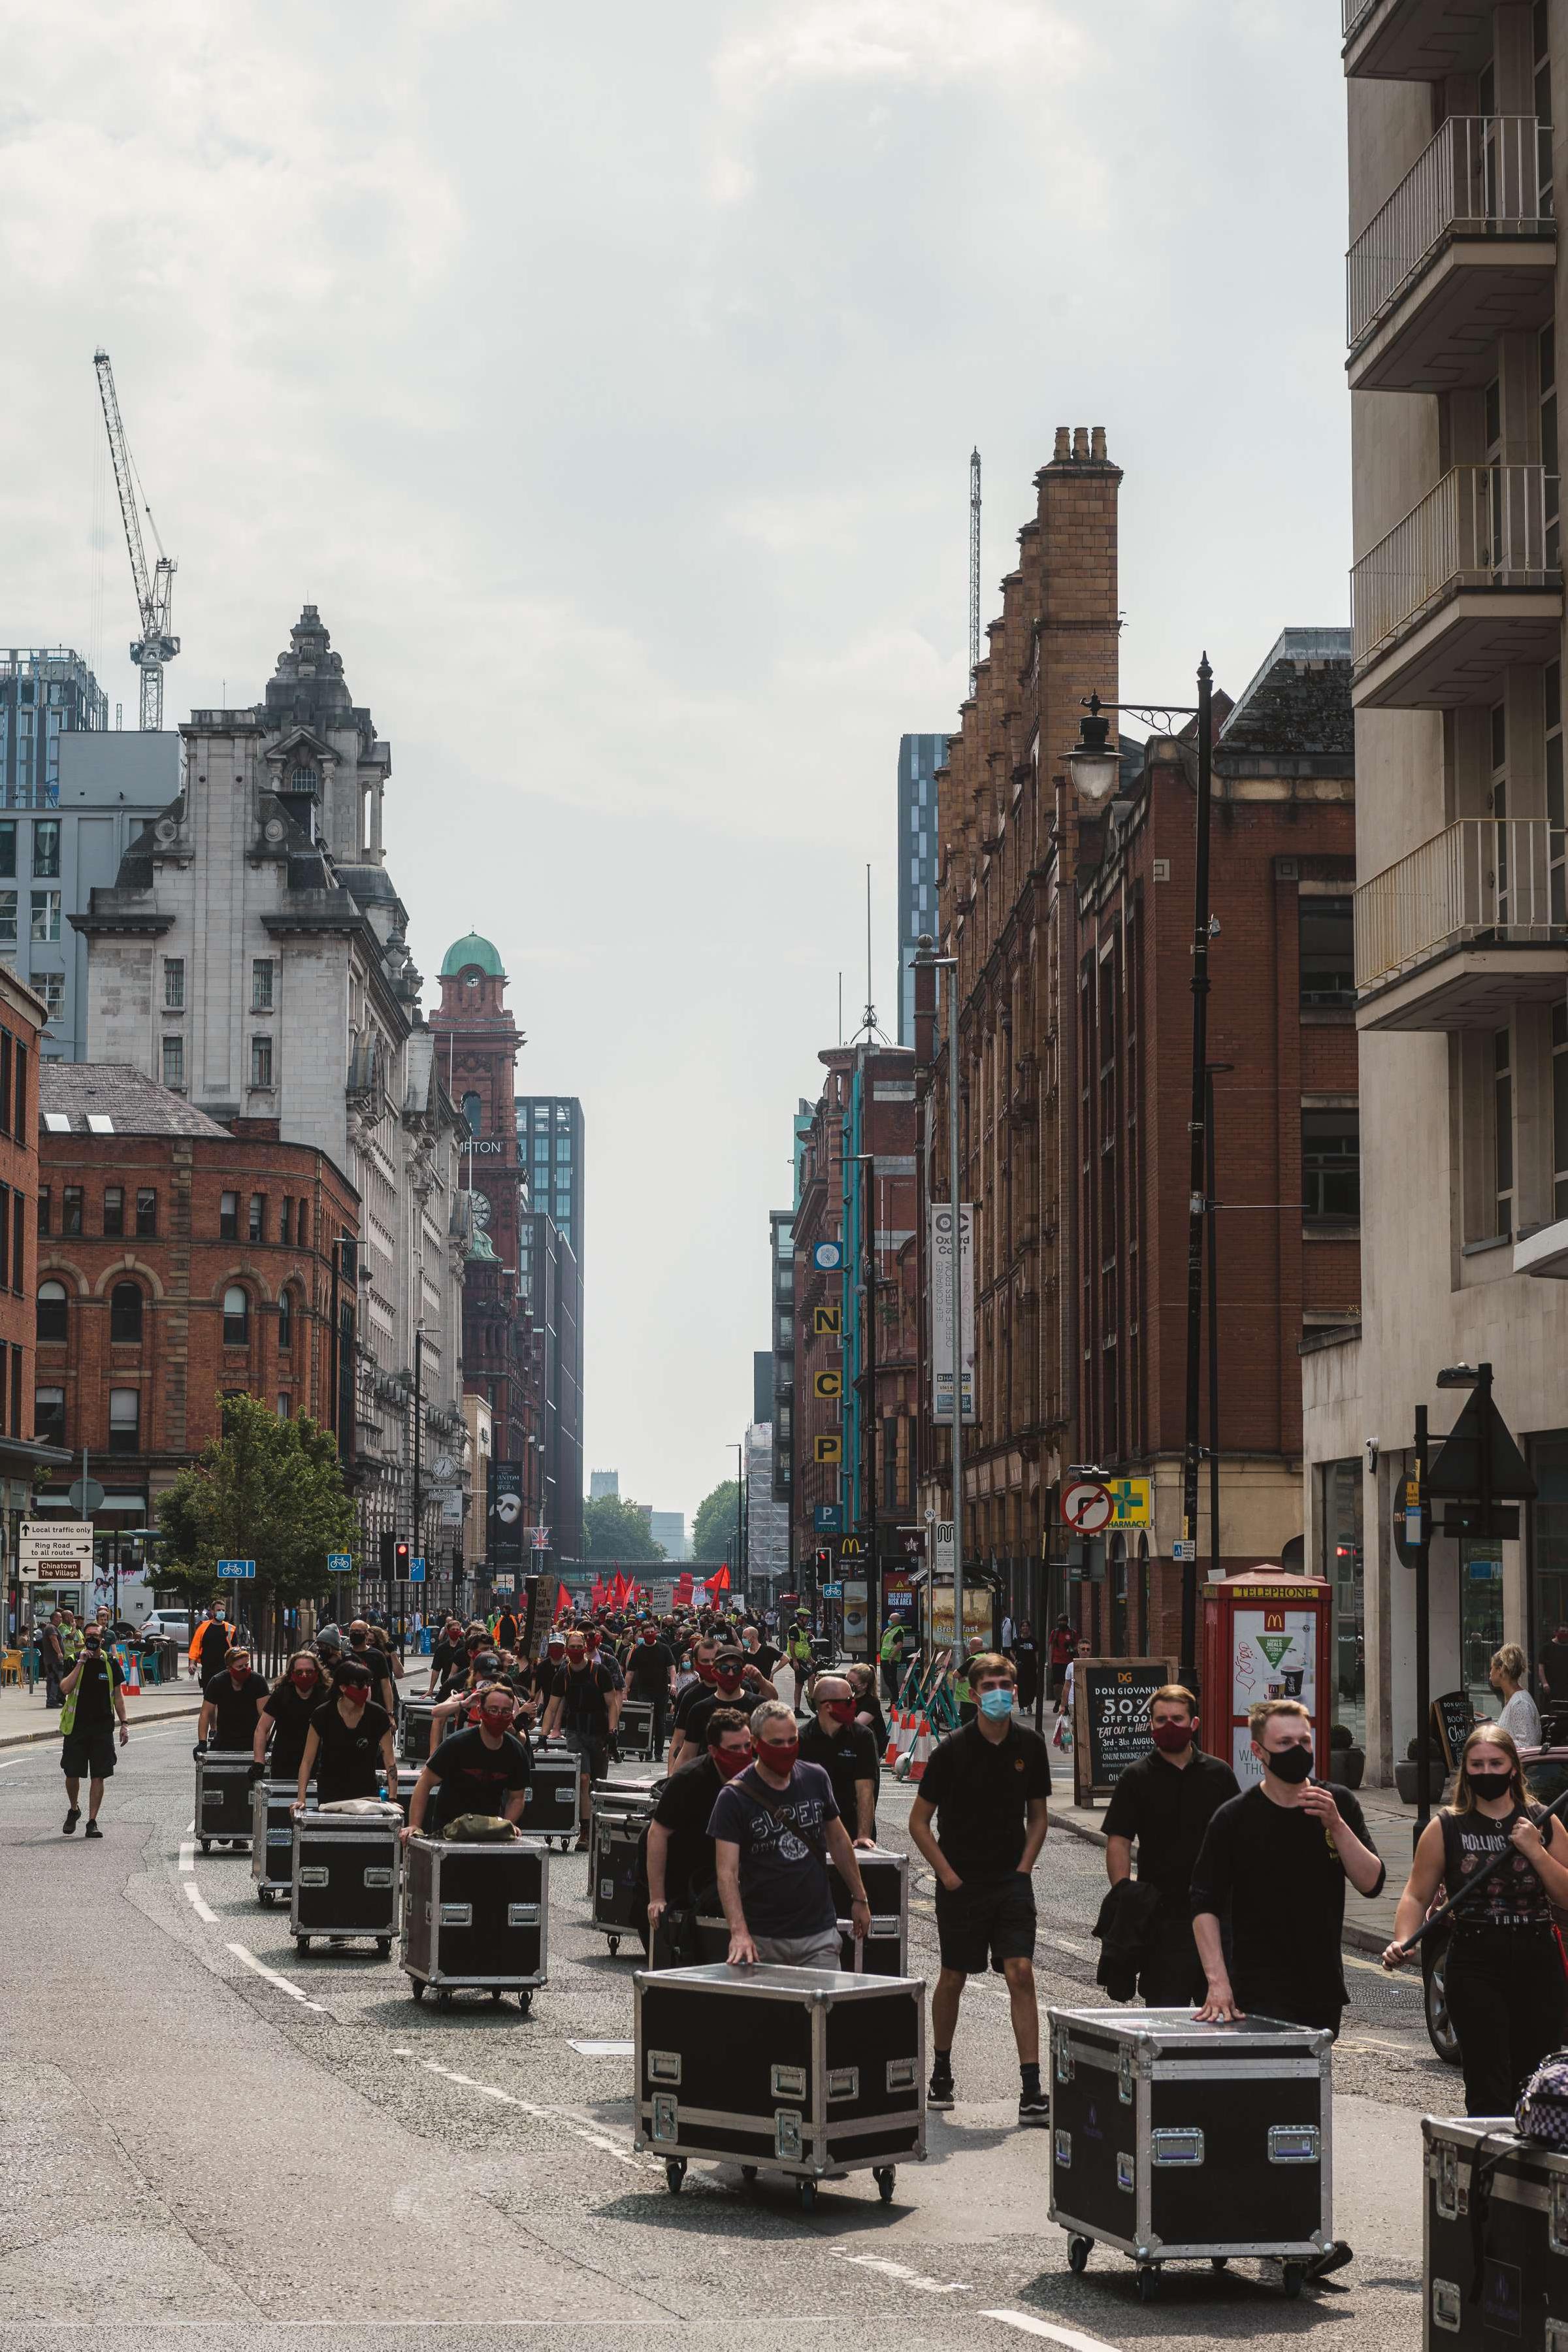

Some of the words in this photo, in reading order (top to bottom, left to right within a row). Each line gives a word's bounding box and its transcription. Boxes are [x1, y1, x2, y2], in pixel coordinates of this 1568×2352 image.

[936, 1235, 970, 1245] Oxrd
[938, 1246, 967, 1254] Cot
[823, 1507, 833, 1520] P
[1239, 1588, 1313, 1598] TELEPHONE
[1118, 1673, 1133, 1683] DG
[1118, 1686, 1161, 1695] GIOVANN
[1104, 1699, 1151, 1715] 50%
[1113, 1725, 1128, 1735] OUT
[1102, 1739, 1114, 1747] 3rd
[1102, 1752, 1120, 1761] ONLINE
[1120, 1752, 1142, 1760] BOOKINGS
[751, 1799, 825, 1839] SUPER
[1461, 1831, 1507, 1852] ROLLING
